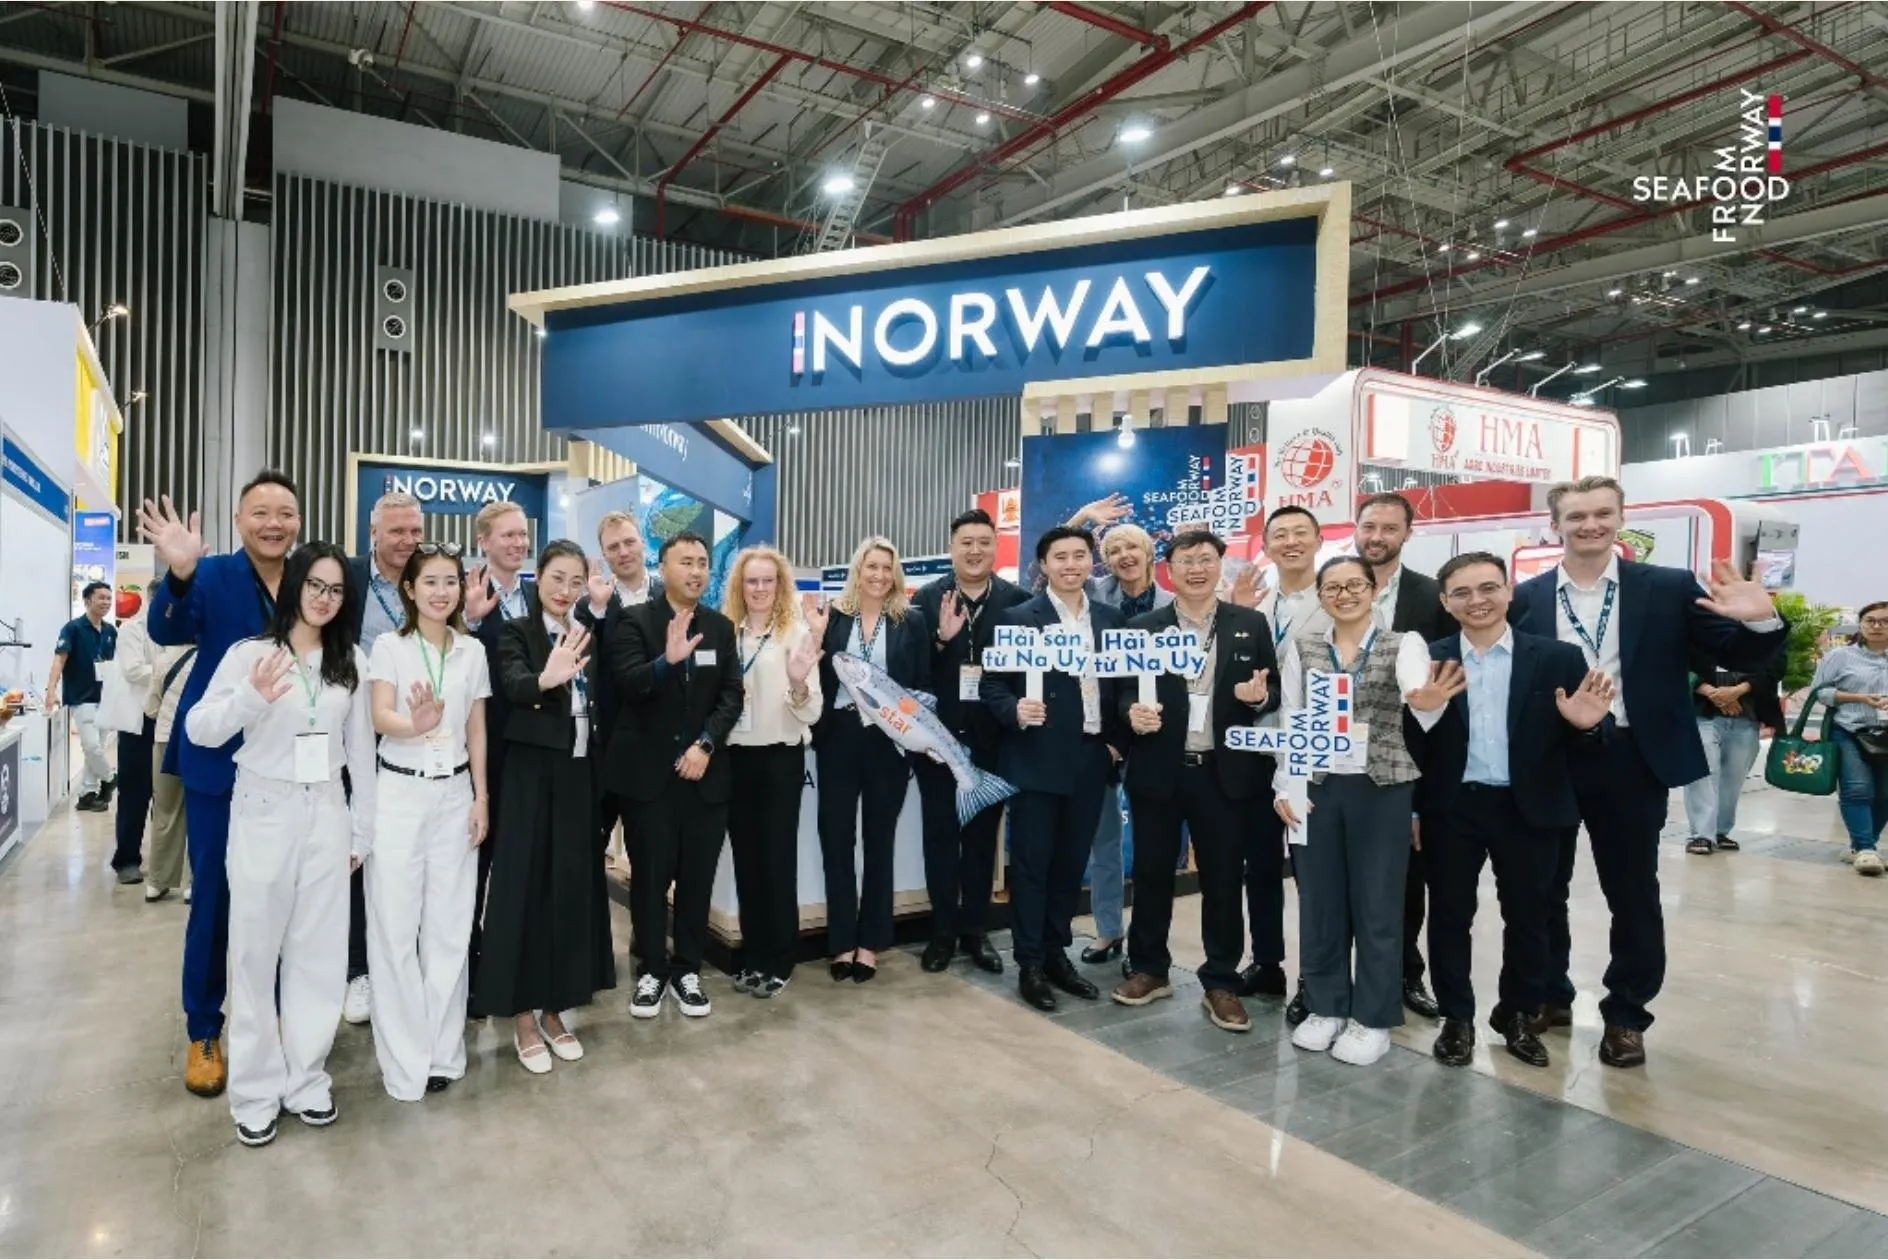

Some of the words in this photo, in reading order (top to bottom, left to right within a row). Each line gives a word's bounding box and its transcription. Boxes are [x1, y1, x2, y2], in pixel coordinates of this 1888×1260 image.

[812, 265, 1210, 373] NORWAY
[1480, 414, 1545, 459] HMA
[1756, 441, 1888, 492] ITA
[393, 475, 516, 503] NORWAY
[1229, 456, 1243, 528] NORWAY
[1279, 490, 1333, 509] HMA
[1169, 501, 1256, 524] SEAFOOD
[1016, 649, 1047, 667] Na
[1058, 649, 1087, 671] Uy
[1126, 653, 1160, 672] Na
[1171, 651, 1204, 674] Uy
[880, 705, 912, 735] star
[1311, 673, 1330, 769] NORWAY
[1230, 730, 1350, 752] SEAFOOD
[1290, 713, 1308, 776] FROM
